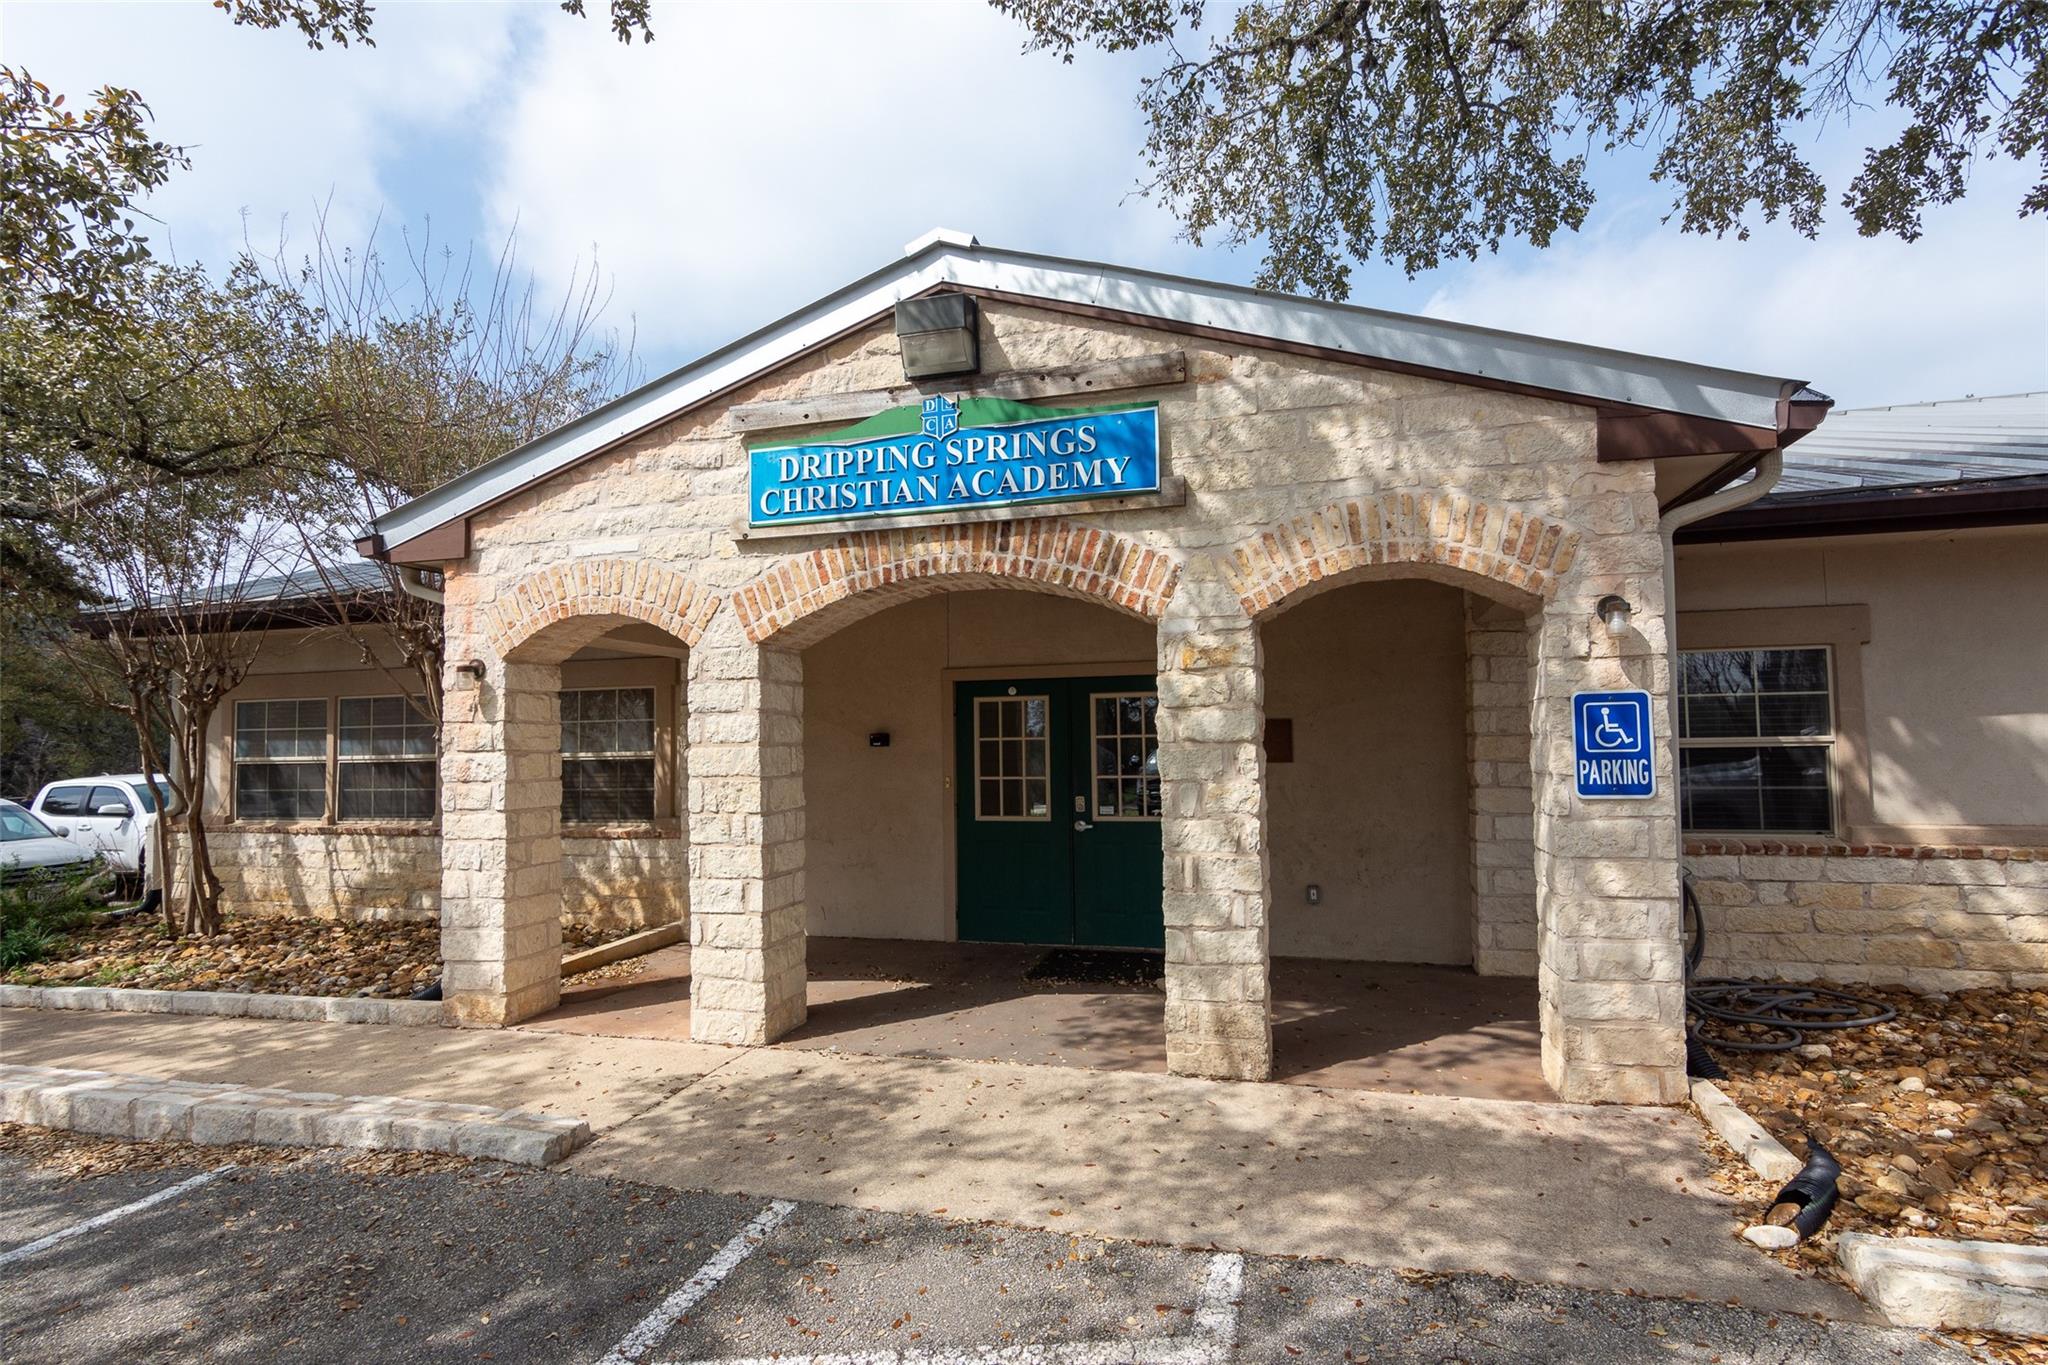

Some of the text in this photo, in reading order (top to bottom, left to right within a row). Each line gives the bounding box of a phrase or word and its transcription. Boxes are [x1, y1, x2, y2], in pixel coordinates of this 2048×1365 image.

[779, 424, 1098, 483] DRIPPING SPRINGS
[760, 456, 1132, 516] CHRISTIAN ACADEMY
[1579, 758, 1649, 785] PARKING
